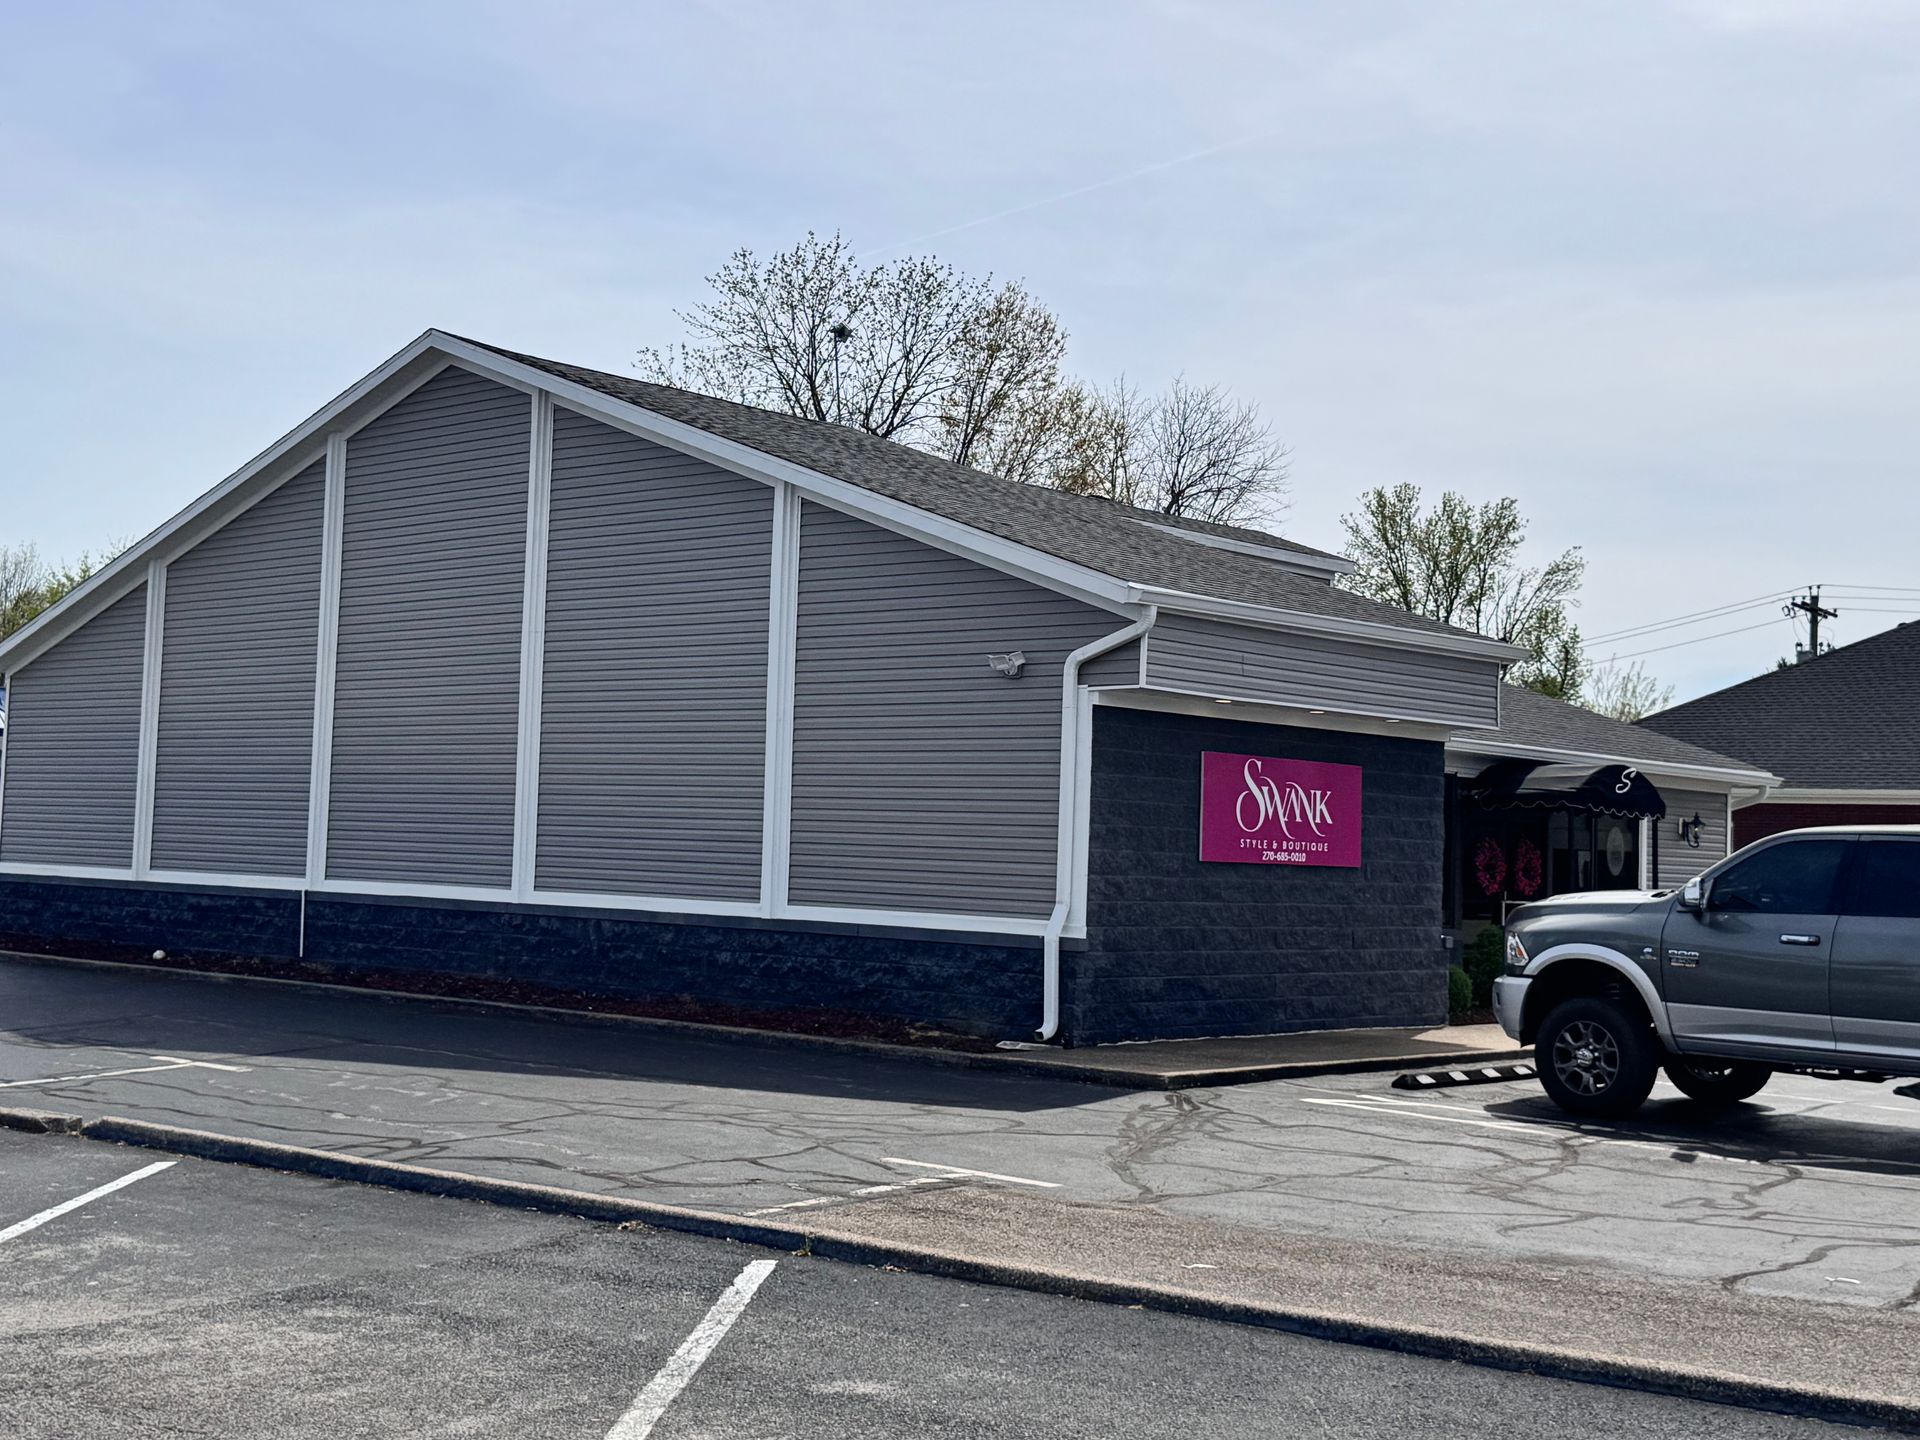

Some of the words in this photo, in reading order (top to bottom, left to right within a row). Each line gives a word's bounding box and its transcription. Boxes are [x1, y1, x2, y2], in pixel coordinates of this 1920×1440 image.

[1615, 767, 1637, 794] S
[1236, 758, 1333, 840] SWANK
[1240, 838, 1268, 849] STYLE
[1272, 840, 1278, 849] &
[1282, 840, 1329, 852] BOUTIQUE
